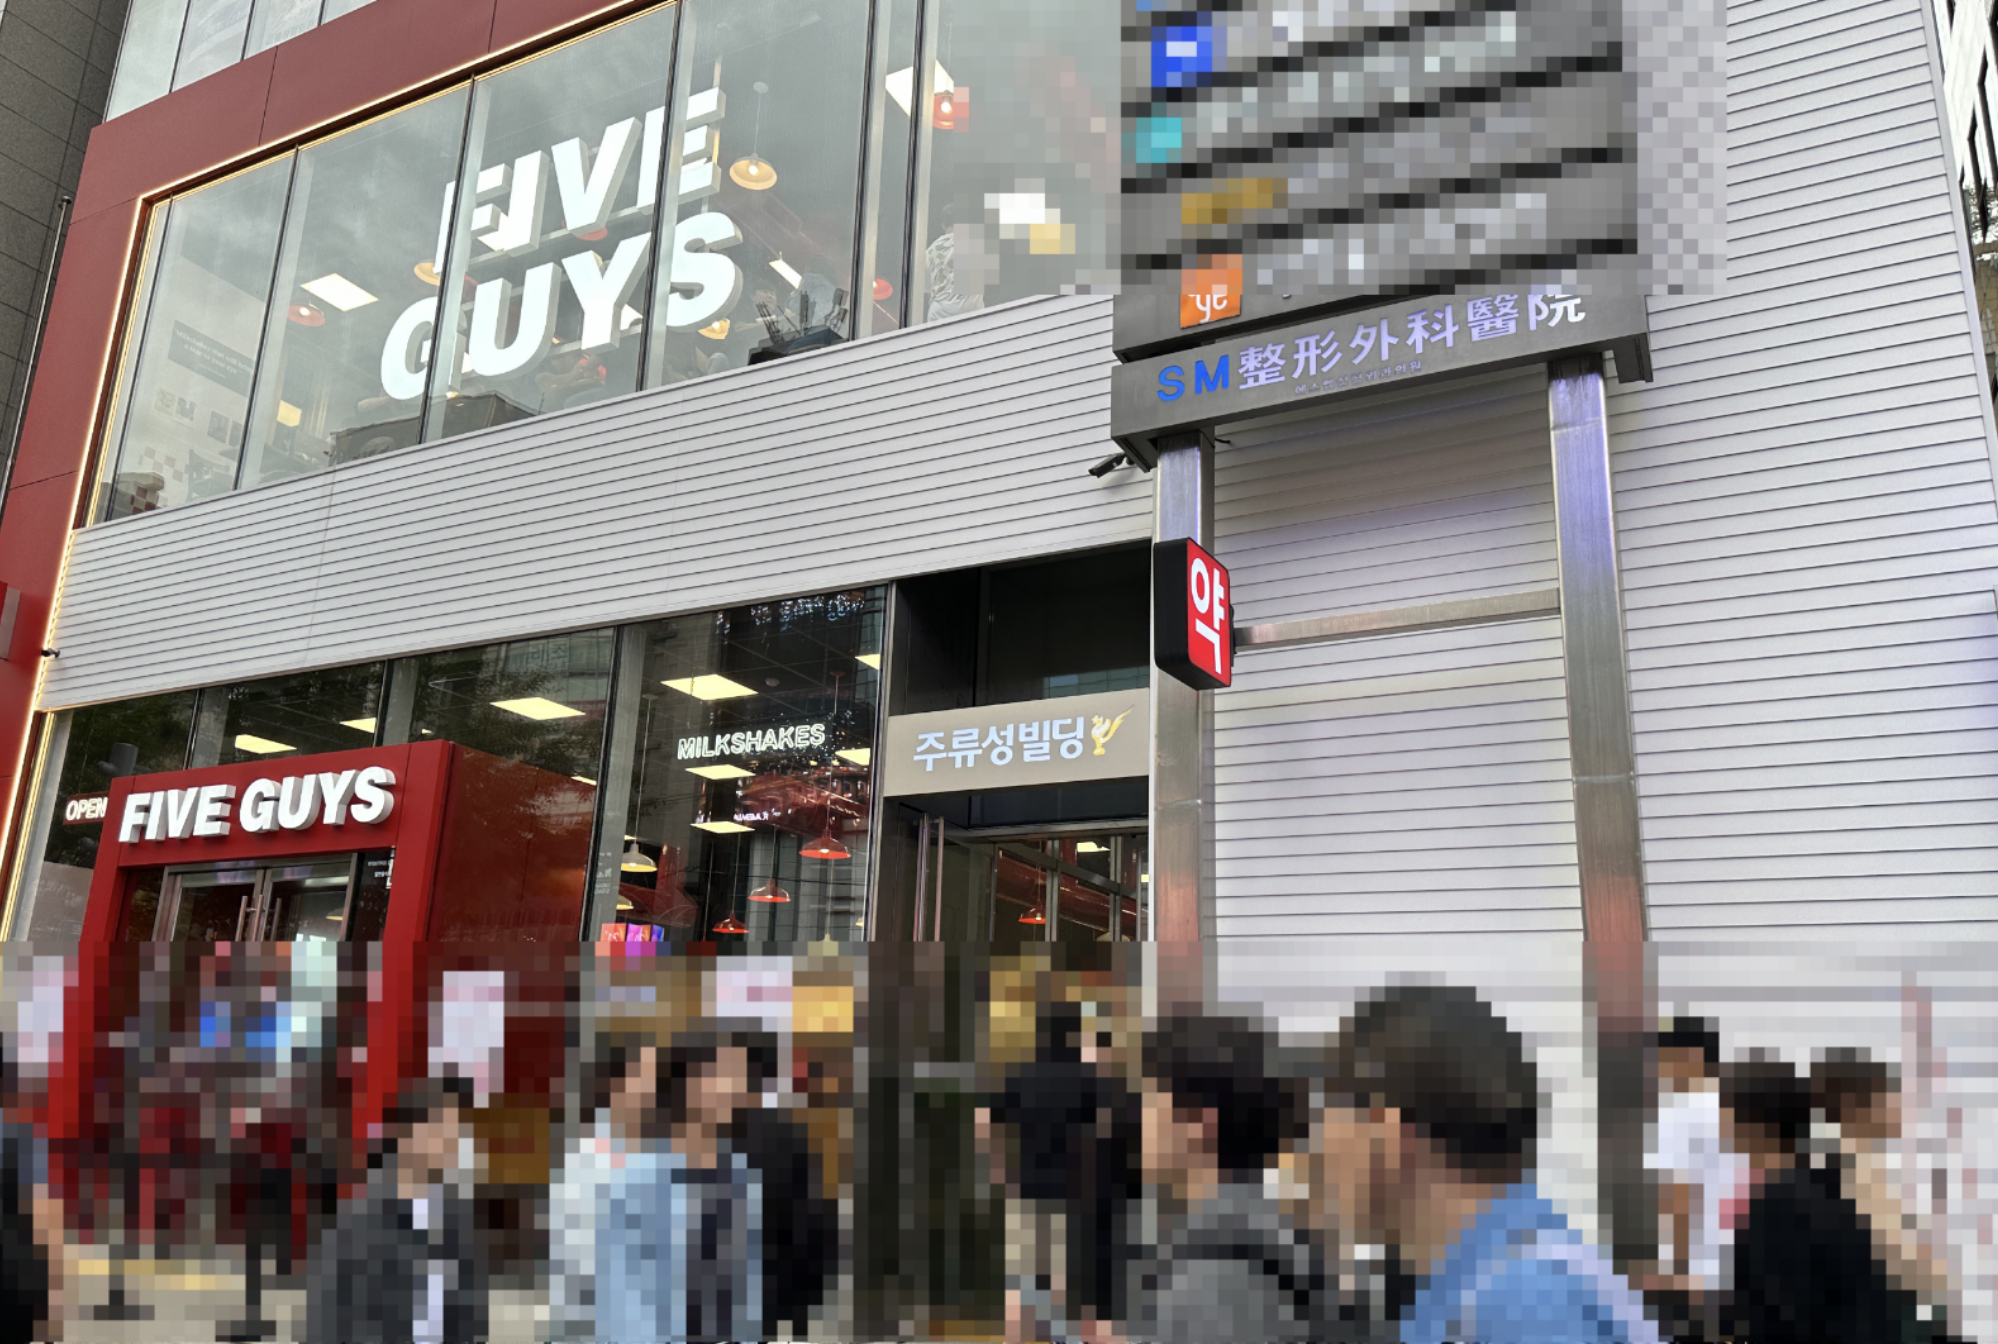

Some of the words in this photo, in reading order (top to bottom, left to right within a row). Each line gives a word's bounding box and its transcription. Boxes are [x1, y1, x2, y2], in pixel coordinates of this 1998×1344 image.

[434, 87, 726, 273] FIVE
[381, 212, 743, 400] GUYS
[1157, 354, 1230, 401] SM
[1238, 294, 1587, 390] 整形外科醫院
[1190, 557, 1225, 675] 약
[677, 723, 826, 760] MILKSHAKES
[913, 716, 1085, 772] 주류성빌딩
[66, 796, 108, 821] OPEN
[118, 784, 236, 843] FIVE
[239, 766, 396, 834] GUYS
